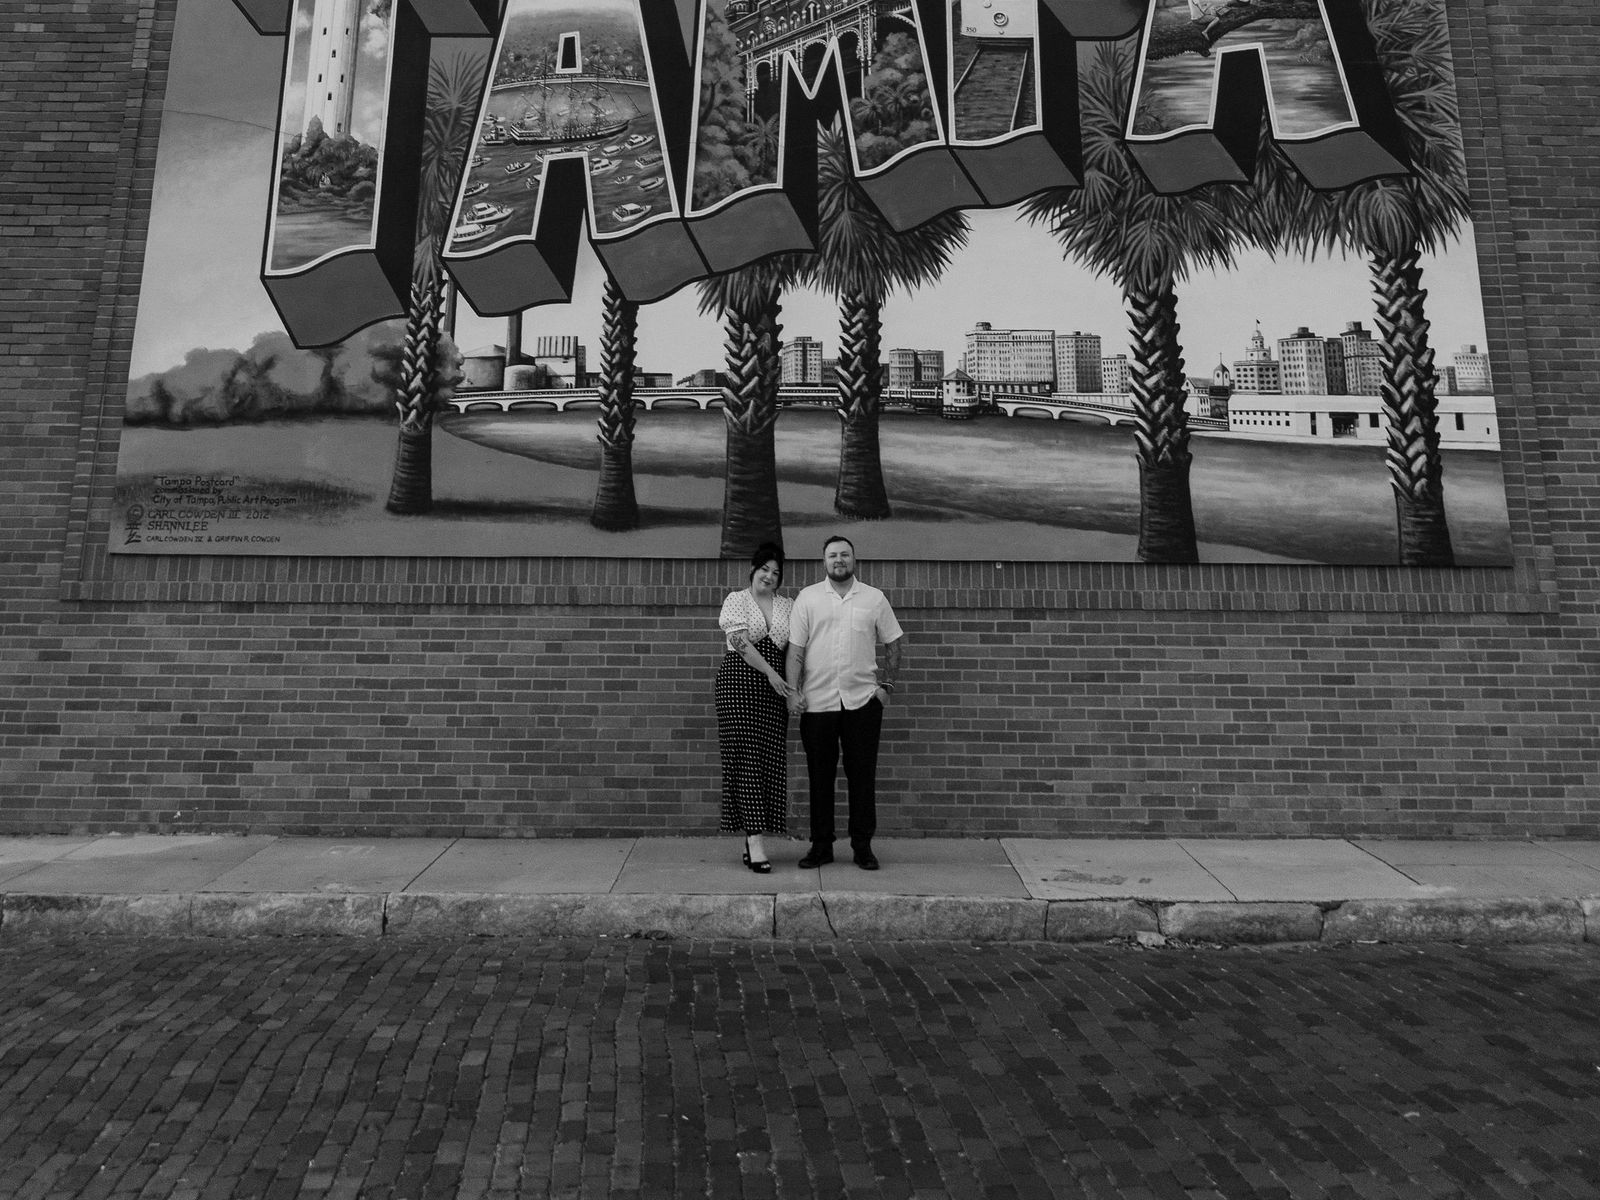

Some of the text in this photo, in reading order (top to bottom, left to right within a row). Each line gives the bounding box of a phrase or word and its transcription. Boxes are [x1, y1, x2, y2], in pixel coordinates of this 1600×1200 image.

[212, 487, 224, 496] by
[152, 495, 171, 507] City
[173, 495, 183, 504] of
[217, 495, 241, 505] Public
[242, 495, 260, 504] Art
[261, 495, 296, 507] Program
[148, 509, 178, 520] CARL
[178, 510, 225, 523] COWDEN
[246, 511, 270, 519] 2012
